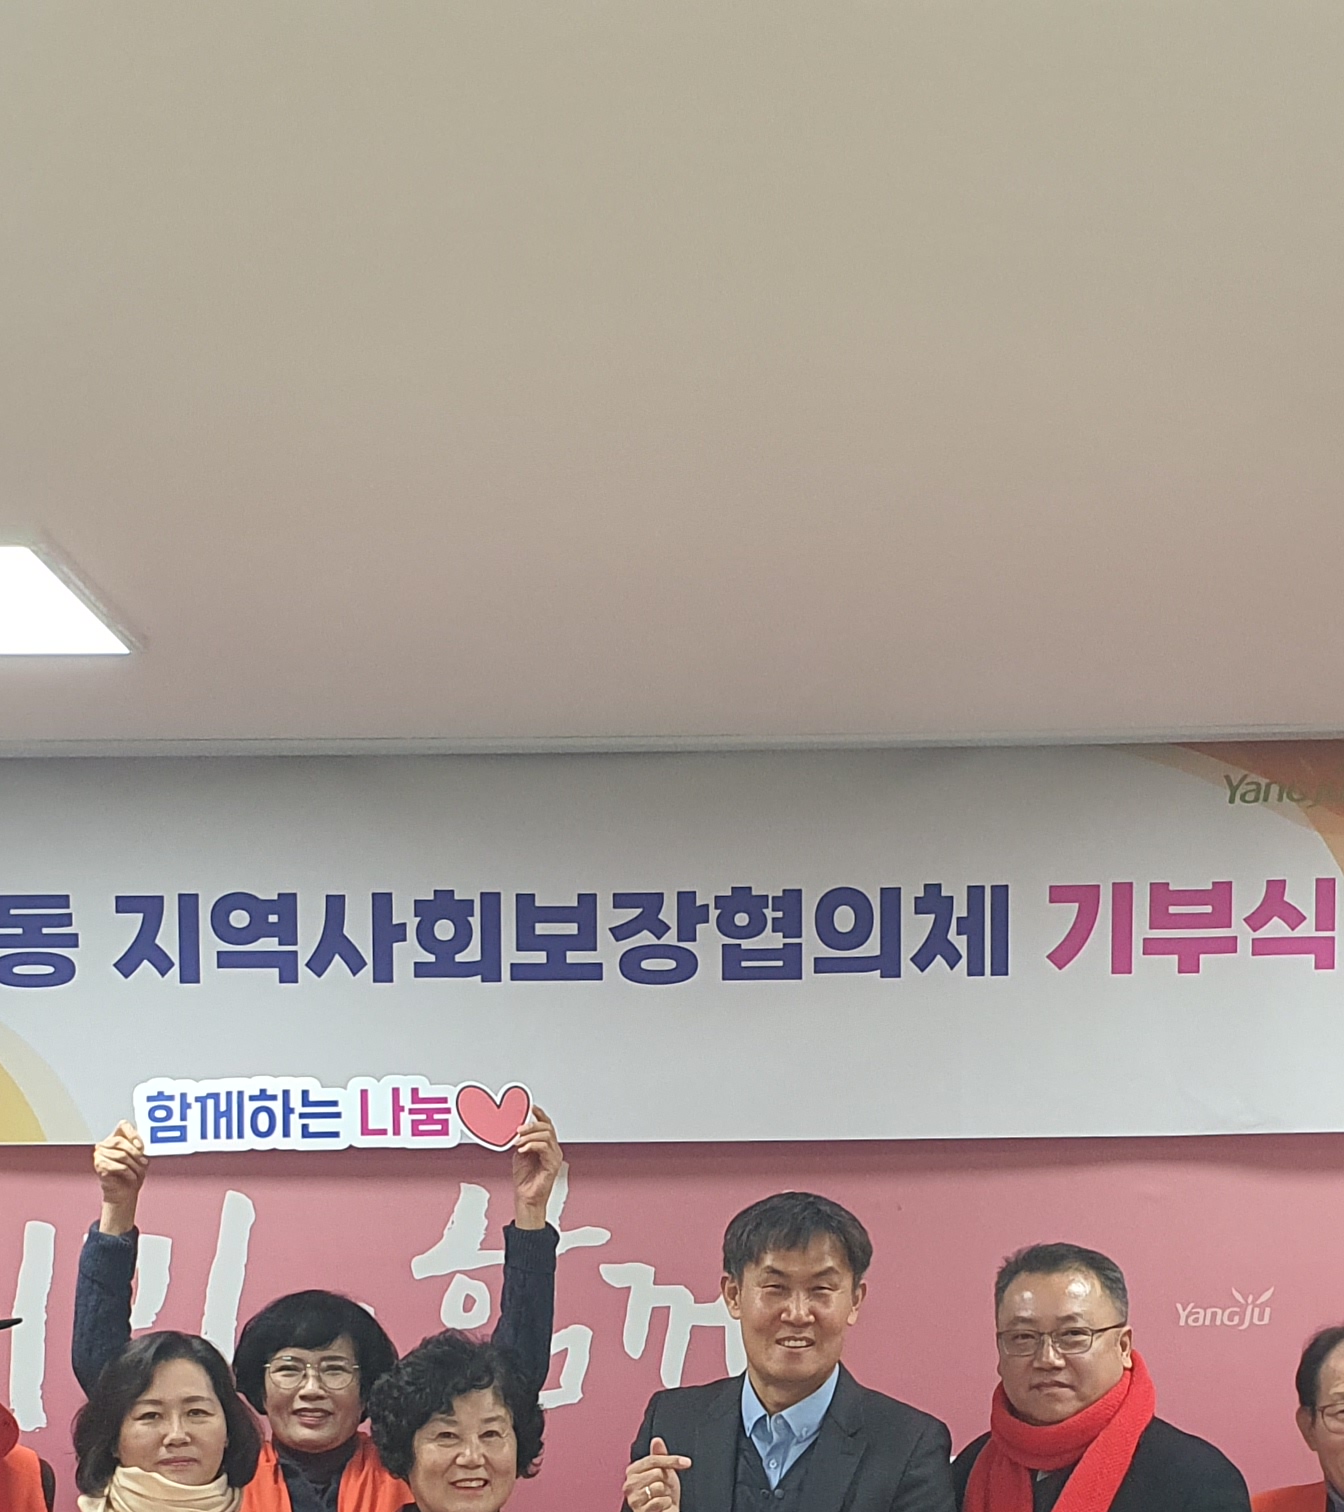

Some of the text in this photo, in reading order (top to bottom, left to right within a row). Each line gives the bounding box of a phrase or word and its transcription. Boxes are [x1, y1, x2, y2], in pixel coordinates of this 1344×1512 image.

[112, 883, 1010, 986] 지역사회보장협의체
[1045, 877, 1337, 976] 기부식
[146, 1086, 452, 1144] 함께하는 나눔
